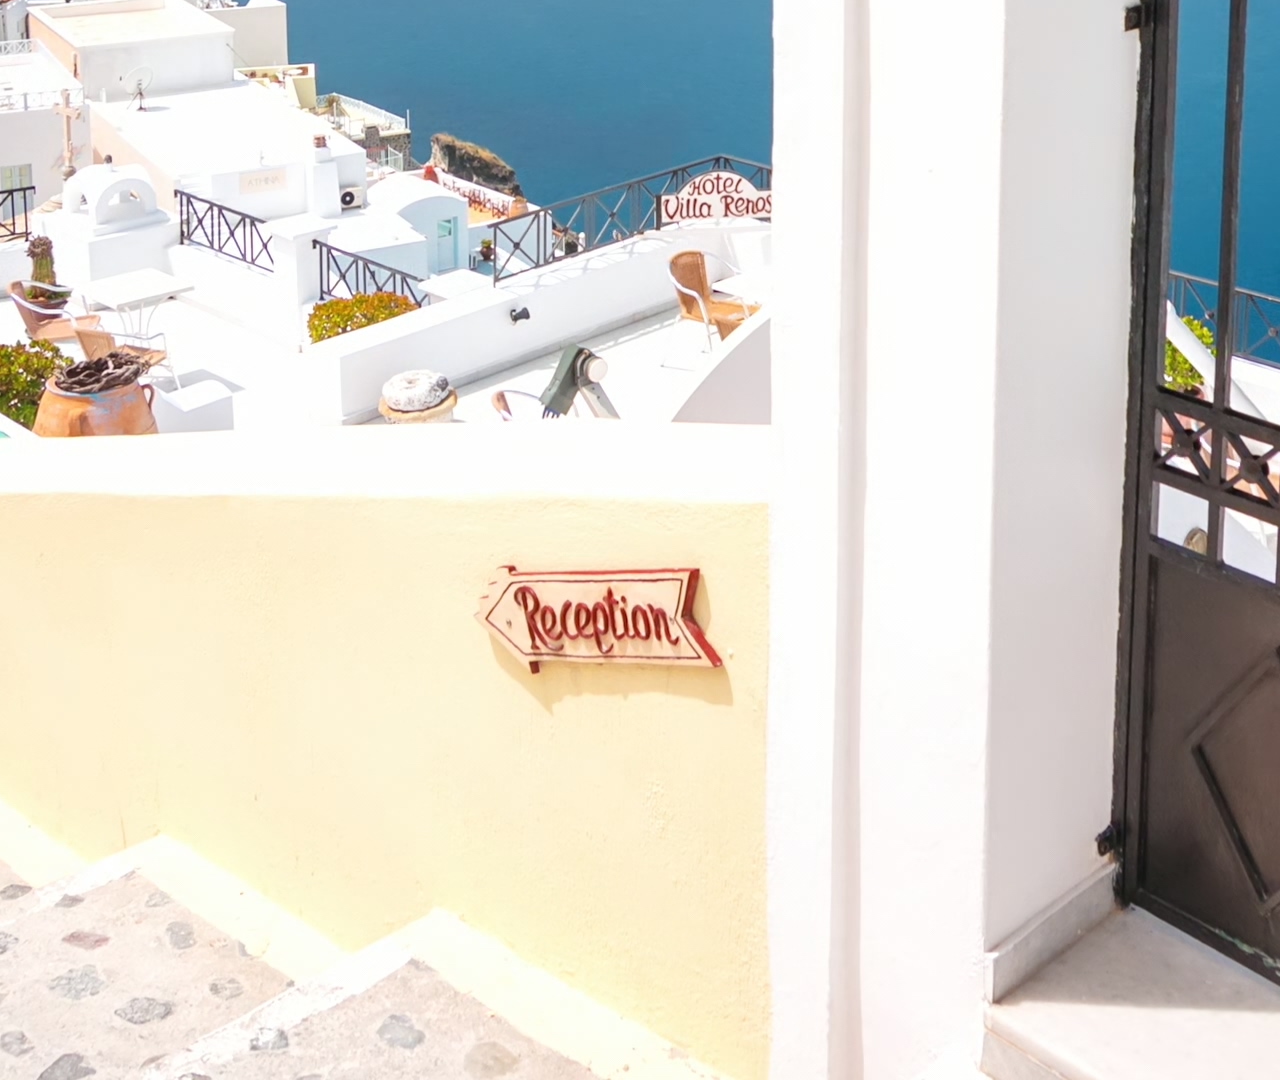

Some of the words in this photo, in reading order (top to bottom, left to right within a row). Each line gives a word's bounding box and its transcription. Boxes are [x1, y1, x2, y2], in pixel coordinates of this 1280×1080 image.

[688, 174, 744, 195] Hotel
[664, 196, 713, 219] Villa
[721, 195, 771, 217] Renos
[513, 586, 681, 655] Reception
